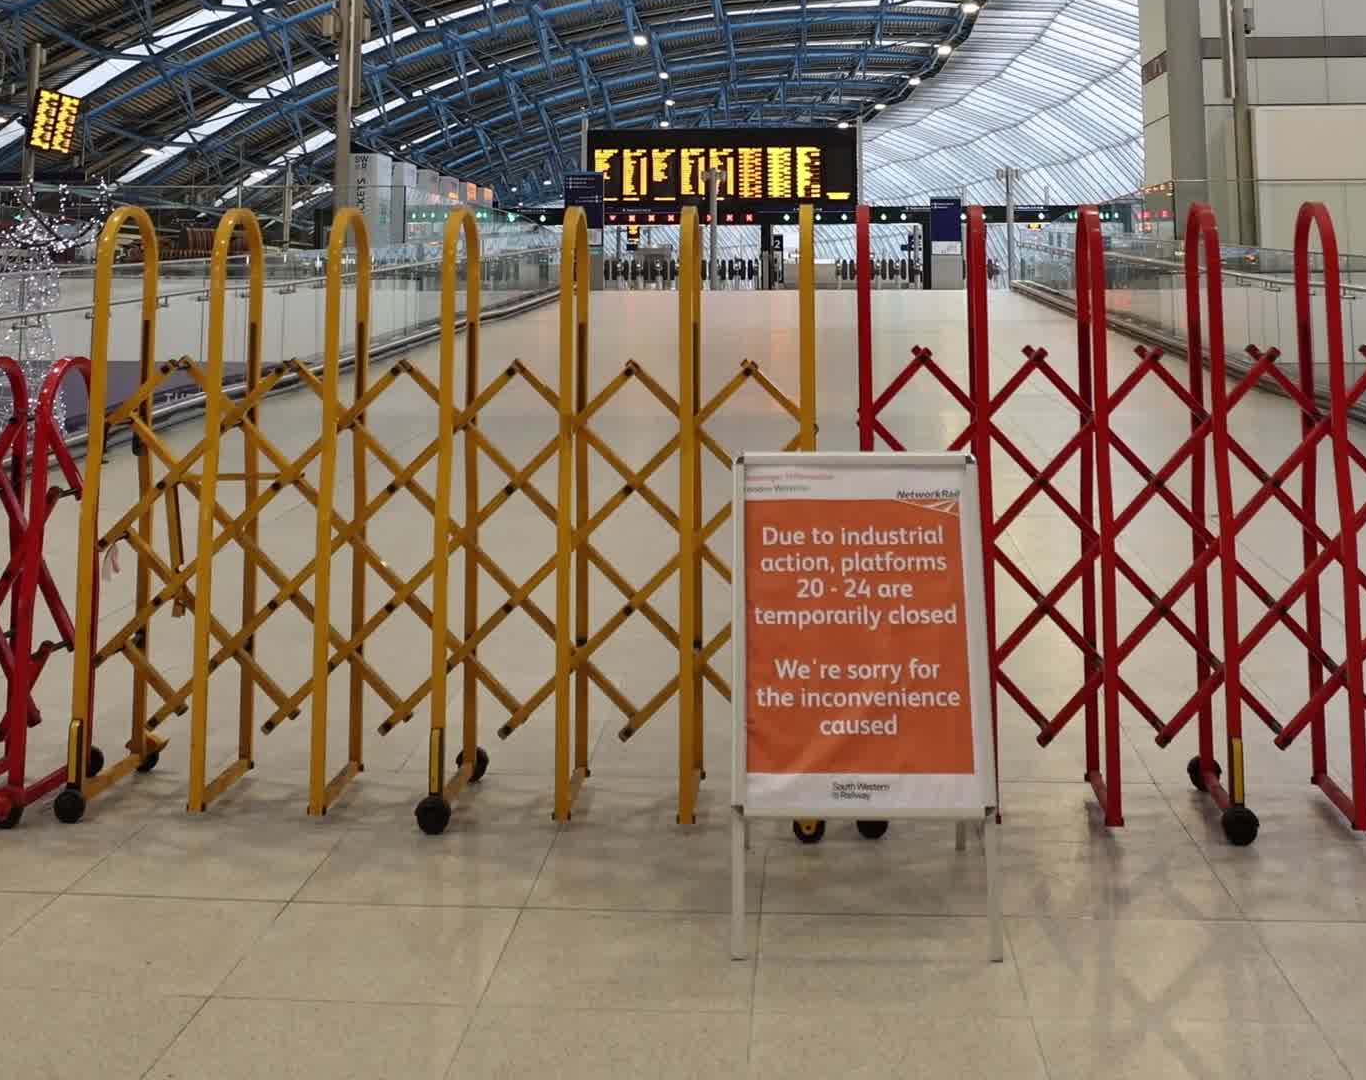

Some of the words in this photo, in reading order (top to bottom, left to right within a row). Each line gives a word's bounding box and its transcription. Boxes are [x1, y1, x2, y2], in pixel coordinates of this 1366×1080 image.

[762, 526, 806, 546] Due
[810, 527, 835, 545] to
[840, 525, 944, 546] industrial
[760, 553, 835, 574] action,
[840, 551, 948, 577] platforms
[796, 578, 825, 599] 20
[843, 578, 871, 599] 24
[877, 583, 914, 598] are
[754, 605, 882, 631] temporarily
[888, 603, 957, 625] closed
[774, 658, 842, 680] We're
[847, 663, 902, 685] sorry
[908, 658, 940, 680] for
[756, 686, 795, 707] the
[800, 687, 961, 708] inconvenience
[819, 714, 898, 736] caused
